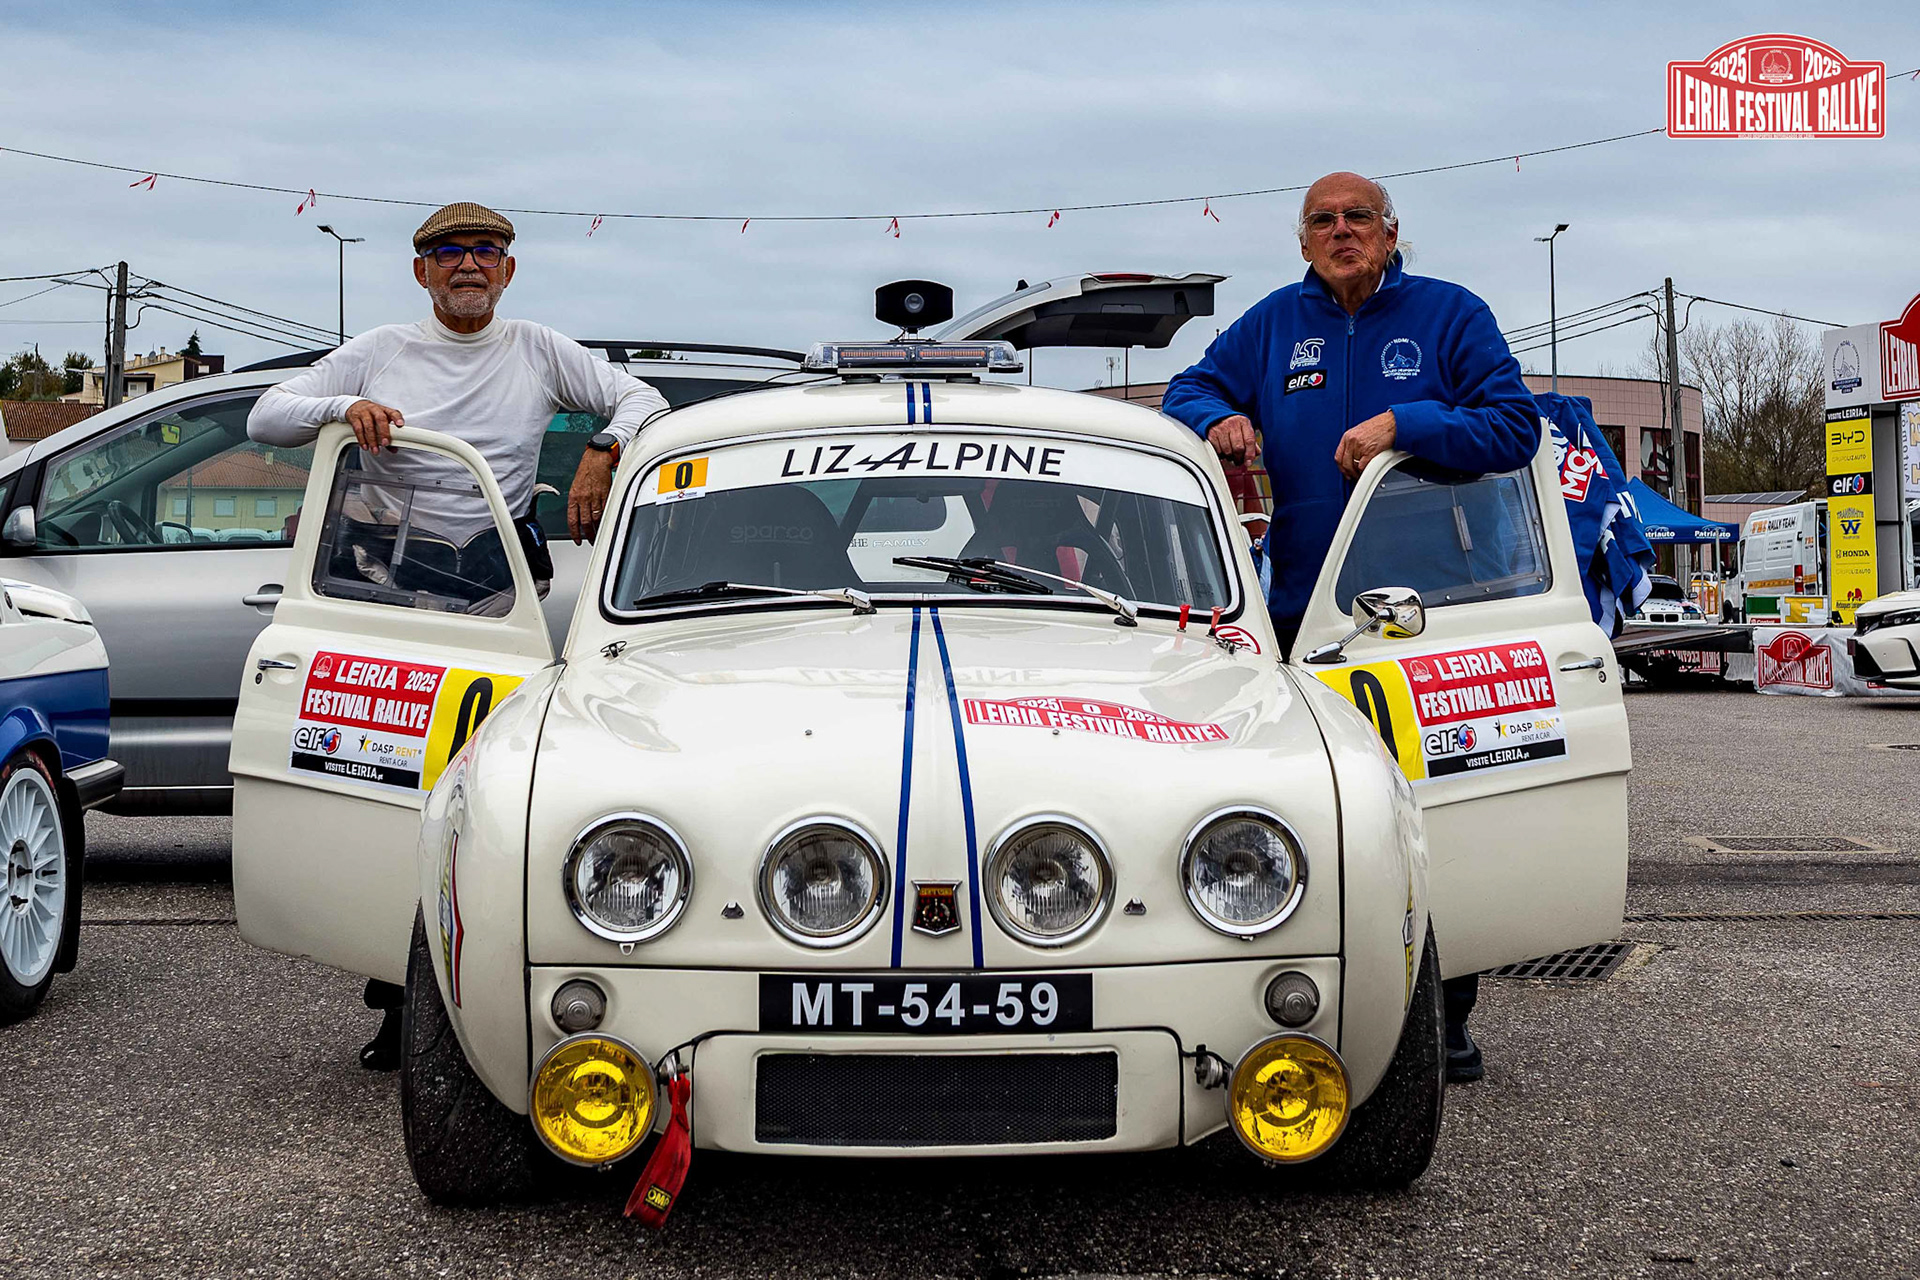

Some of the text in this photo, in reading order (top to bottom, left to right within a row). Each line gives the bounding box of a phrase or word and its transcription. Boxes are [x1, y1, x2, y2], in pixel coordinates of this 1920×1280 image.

[1883, 330, 1920, 393] LEIRIA
[1288, 374, 1309, 389] elf
[1831, 430, 1865, 445] BYD
[781, 441, 1066, 477] LIZ ALPINE
[675, 461, 693, 490] 0
[1832, 475, 1853, 494] elf
[1768, 519, 1782, 531] RALLY
[1782, 517, 1797, 528] TEAM
[873, 538, 930, 548] FAMILY
[1842, 549, 1870, 557] HONDA
[1434, 651, 1507, 681] LEIRIA
[1509, 647, 1543, 669] 2025
[334, 659, 399, 691] LEIRIA
[403, 669, 439, 693] 2025
[1017, 698, 1059, 711] 2025
[1081, 703, 1102, 714] 0
[1418, 676, 1551, 719] FESTIVAL RALLYE
[304, 688, 429, 730] FESTIVAL RALLYE
[974, 700, 1044, 726] LEIRIA
[1046, 710, 1143, 738] FESTIVAL
[1143, 723, 1220, 743] RALLYE
[1510, 721, 1533, 734] DASP
[294, 727, 324, 750] elf
[1425, 727, 1459, 755] elf
[1521, 732, 1551, 743] RENT A CAR
[371, 742, 394, 755] DASP
[324, 761, 346, 774] VISITE
[379, 756, 408, 767] RENT A CAR
[1465, 755, 1489, 768] VISITE
[792, 981, 1059, 1026] MT-54-59
[647, 1189, 670, 1206] OMP
